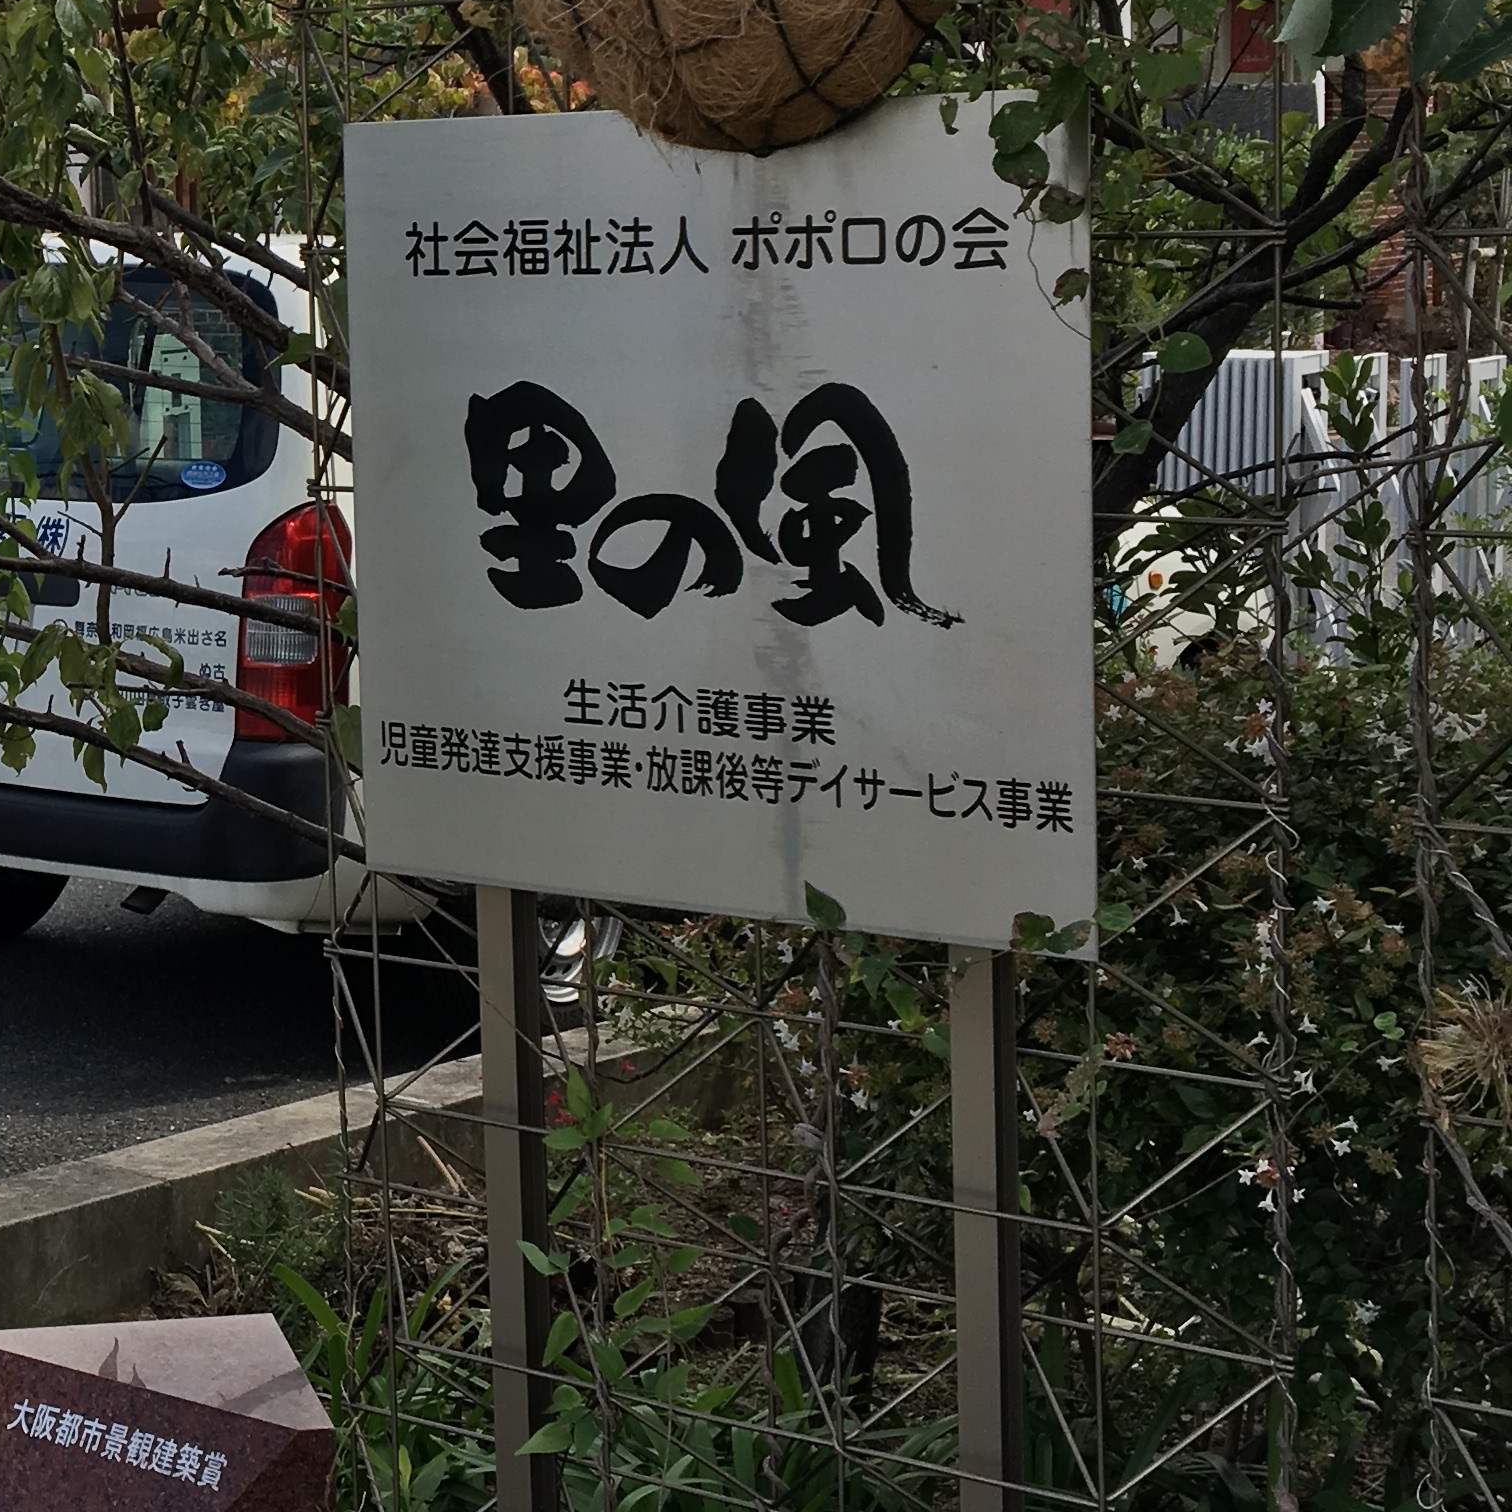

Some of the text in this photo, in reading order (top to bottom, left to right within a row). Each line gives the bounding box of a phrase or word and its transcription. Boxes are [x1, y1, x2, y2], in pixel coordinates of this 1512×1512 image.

[405, 207, 1010, 278] 社会福祉法人 ポポロの会
[463, 380, 966, 631] 里の風
[563, 678, 837, 746] 生活介護事業
[380, 720, 1075, 834] 児童発達支援事業・放課後等デイサービス事業
[6, 1398, 229, 1492] 大阪都市景観建築賞
